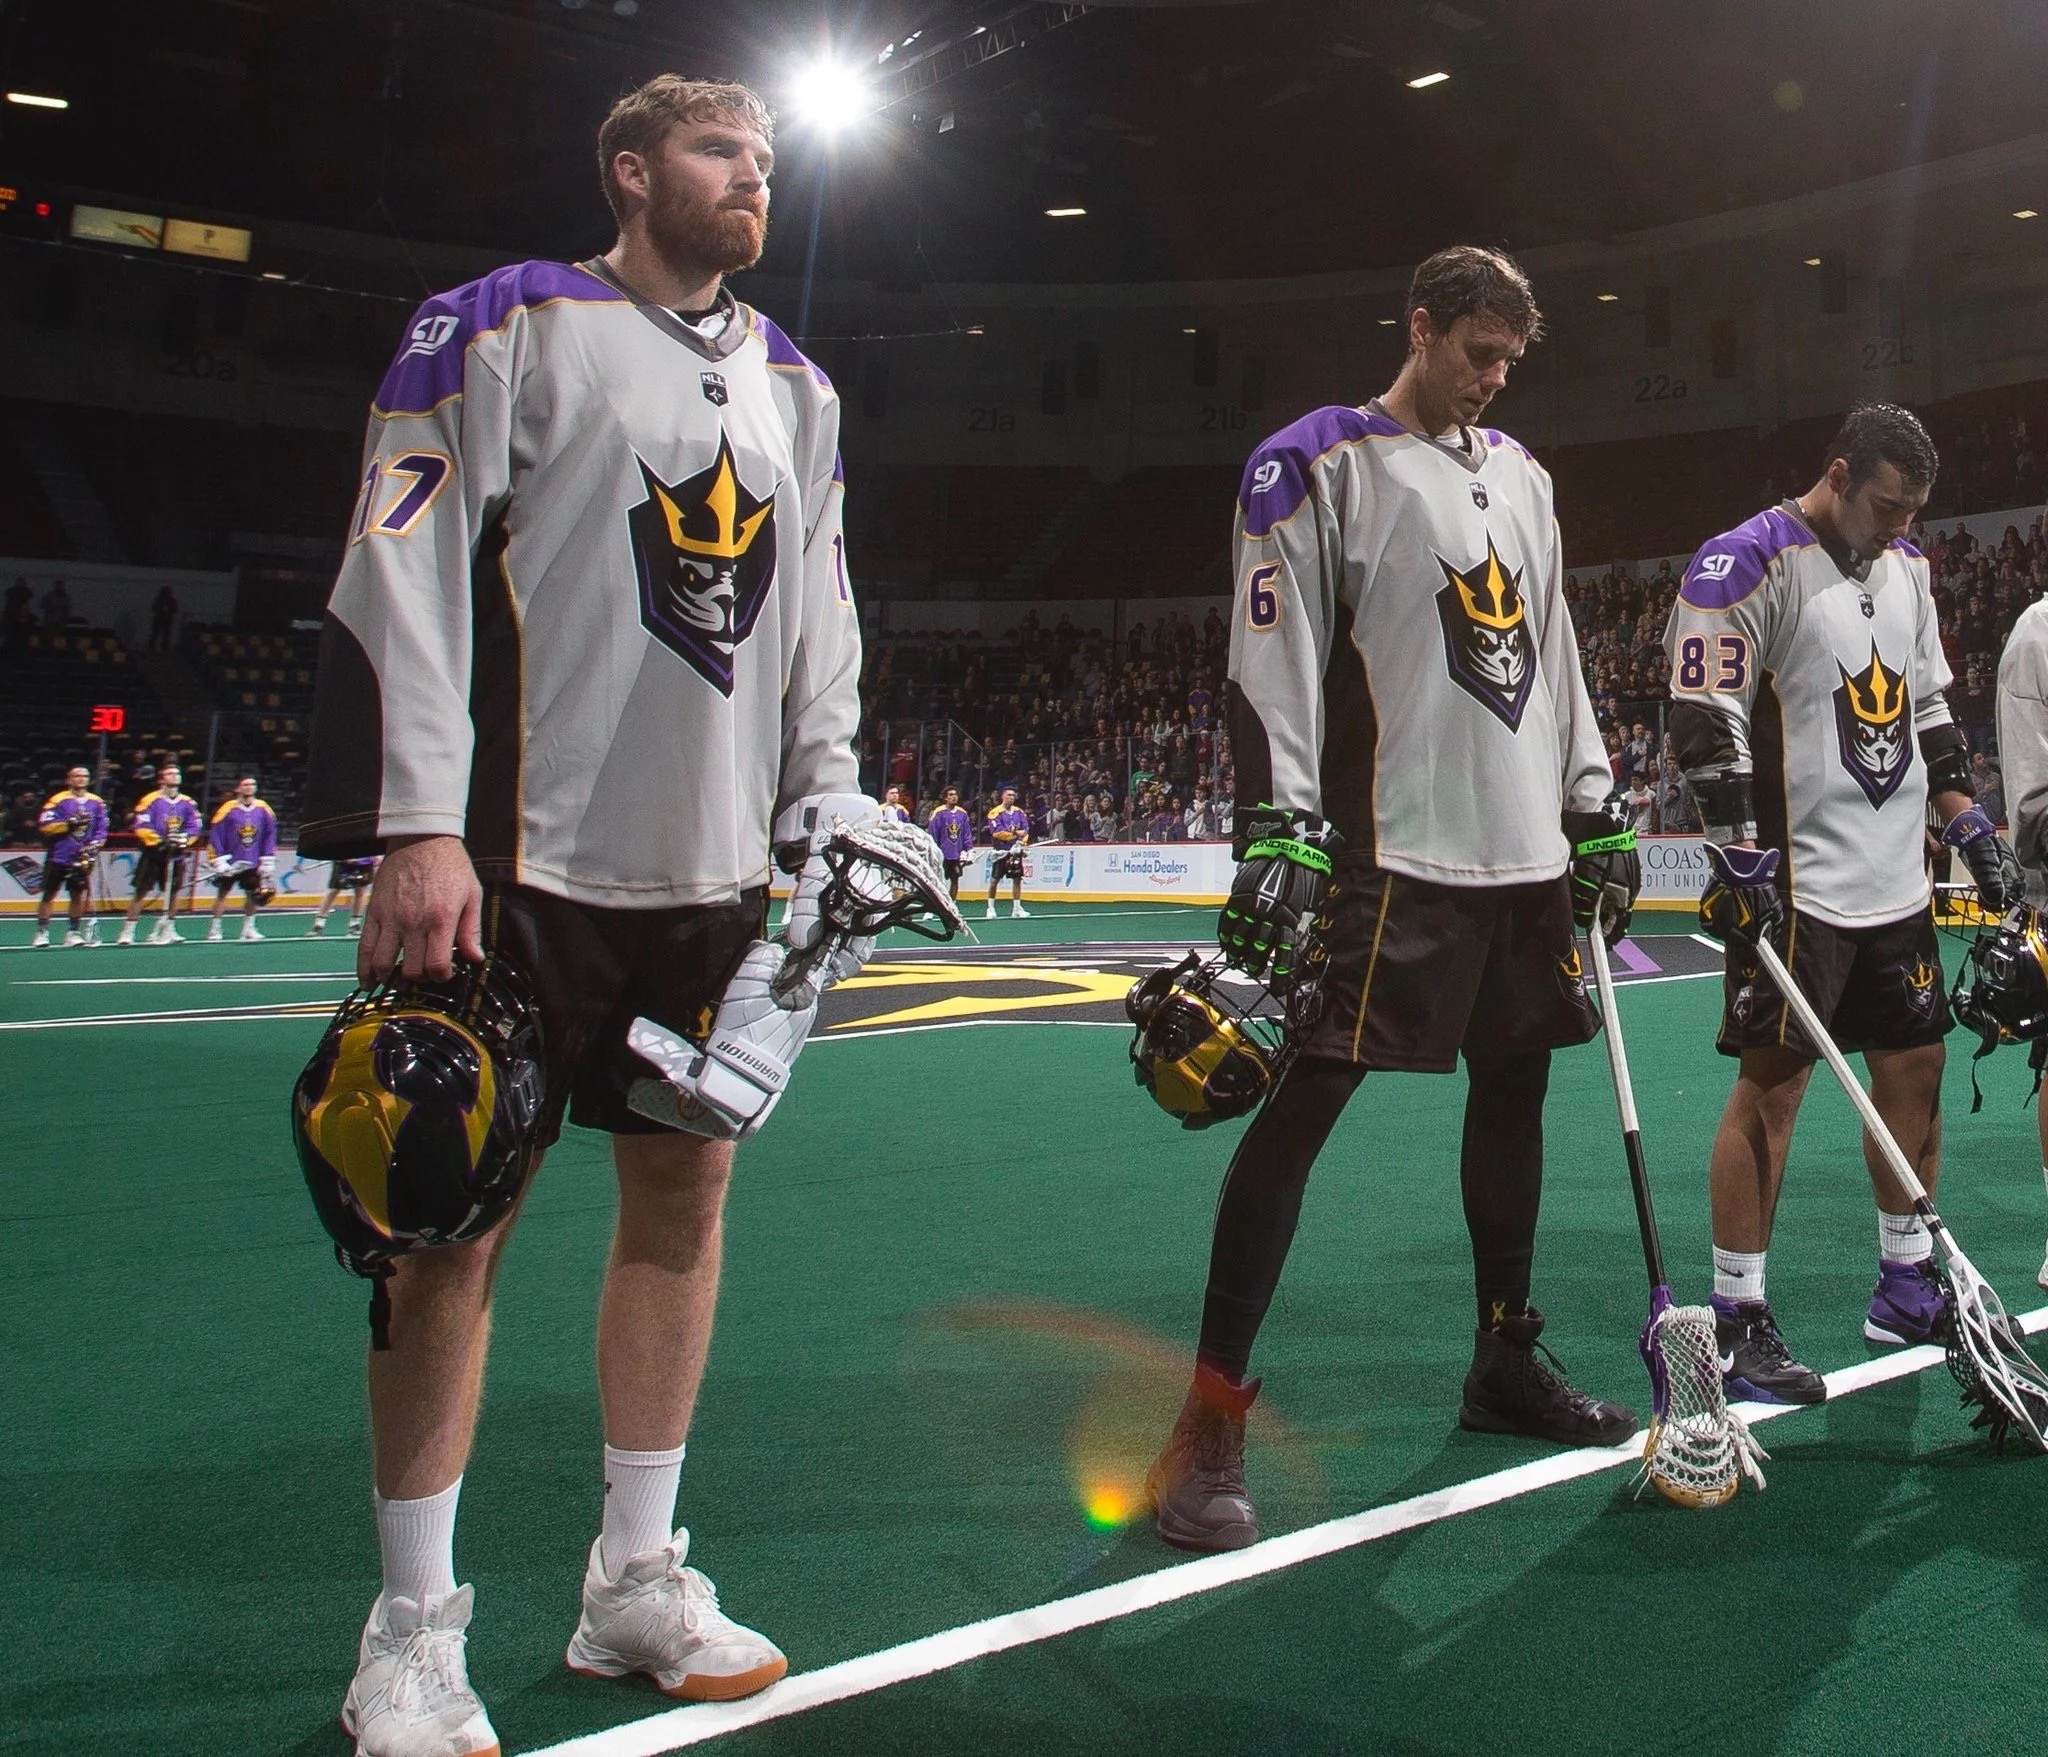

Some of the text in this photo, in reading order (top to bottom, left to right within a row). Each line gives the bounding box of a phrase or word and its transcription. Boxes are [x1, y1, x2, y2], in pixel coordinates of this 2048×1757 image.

[701, 373, 725, 386] NLL
[1635, 375, 1688, 402] 22a
[352, 449, 456, 546] 17
[1247, 560, 1282, 631] 6
[1676, 633, 1750, 693] 83
[91, 708, 124, 731] 30
[1253, 840, 1300, 854] UNDER
[1586, 838, 1627, 851] UNDER
[1647, 844, 1711, 870] COAS
[1123, 860, 1152, 873] Honda
[1154, 860, 1188, 873] Dealers
[716, 1041, 781, 1084] WARRIOR
